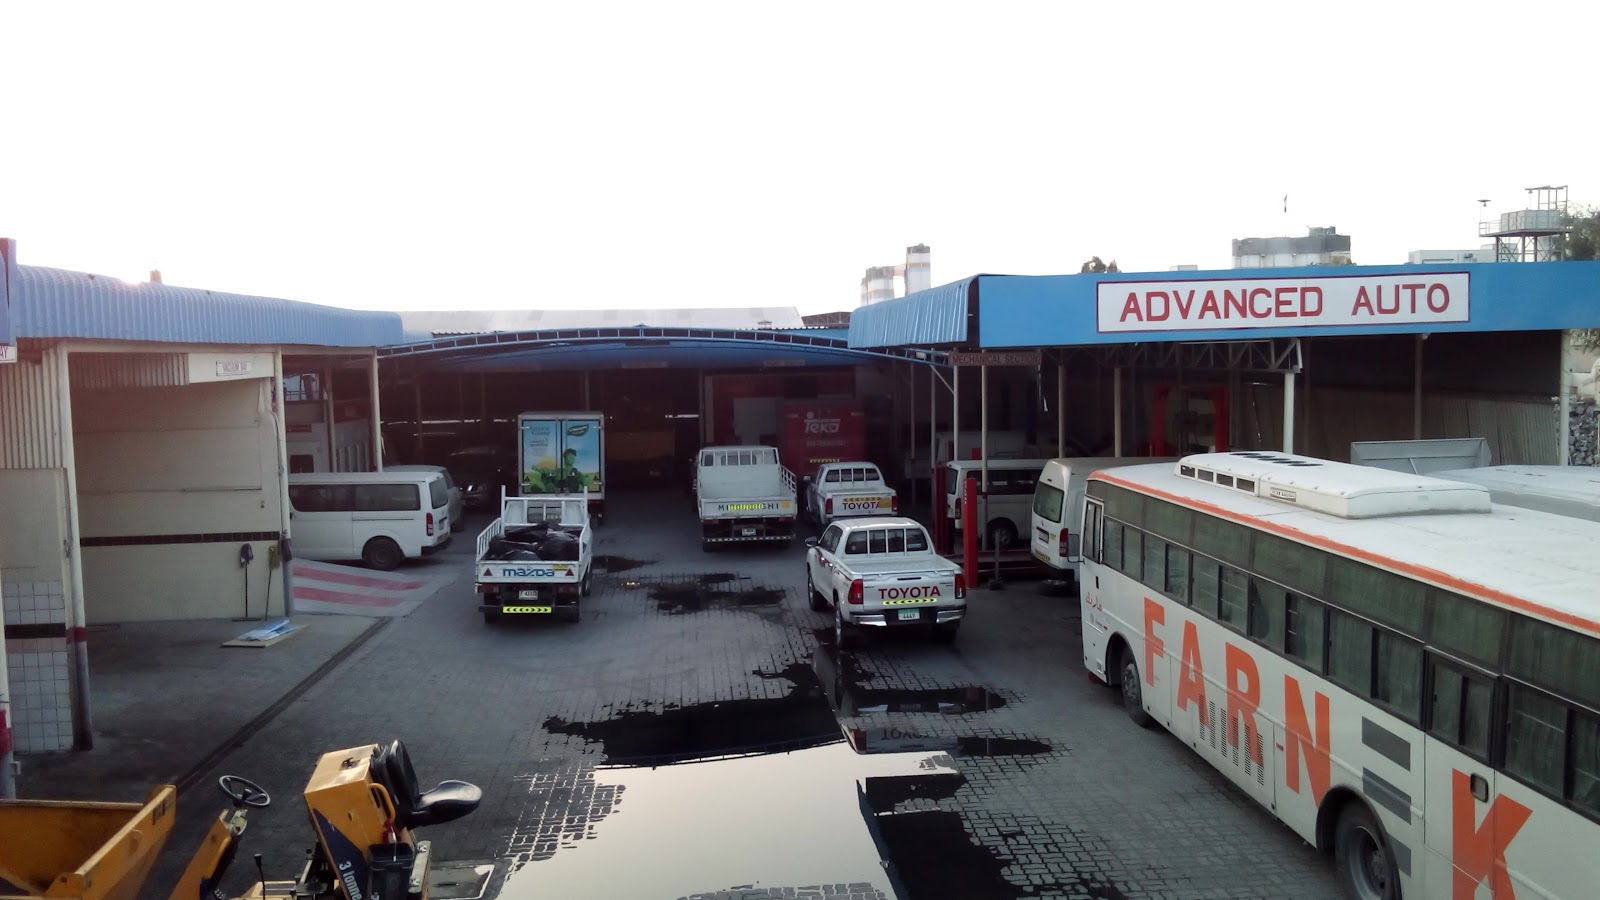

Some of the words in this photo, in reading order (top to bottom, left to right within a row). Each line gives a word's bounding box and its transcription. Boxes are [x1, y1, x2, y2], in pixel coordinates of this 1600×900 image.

[1119, 286, 1323, 322] ADVANCED
[1351, 282, 1450, 316] AUTO
[952, 355, 1001, 364] MECHANICAL
[1005, 354, 1038, 363] SECTION
[878, 586, 941, 599] TOYOTA
[339, 861, 352, 871] 3
